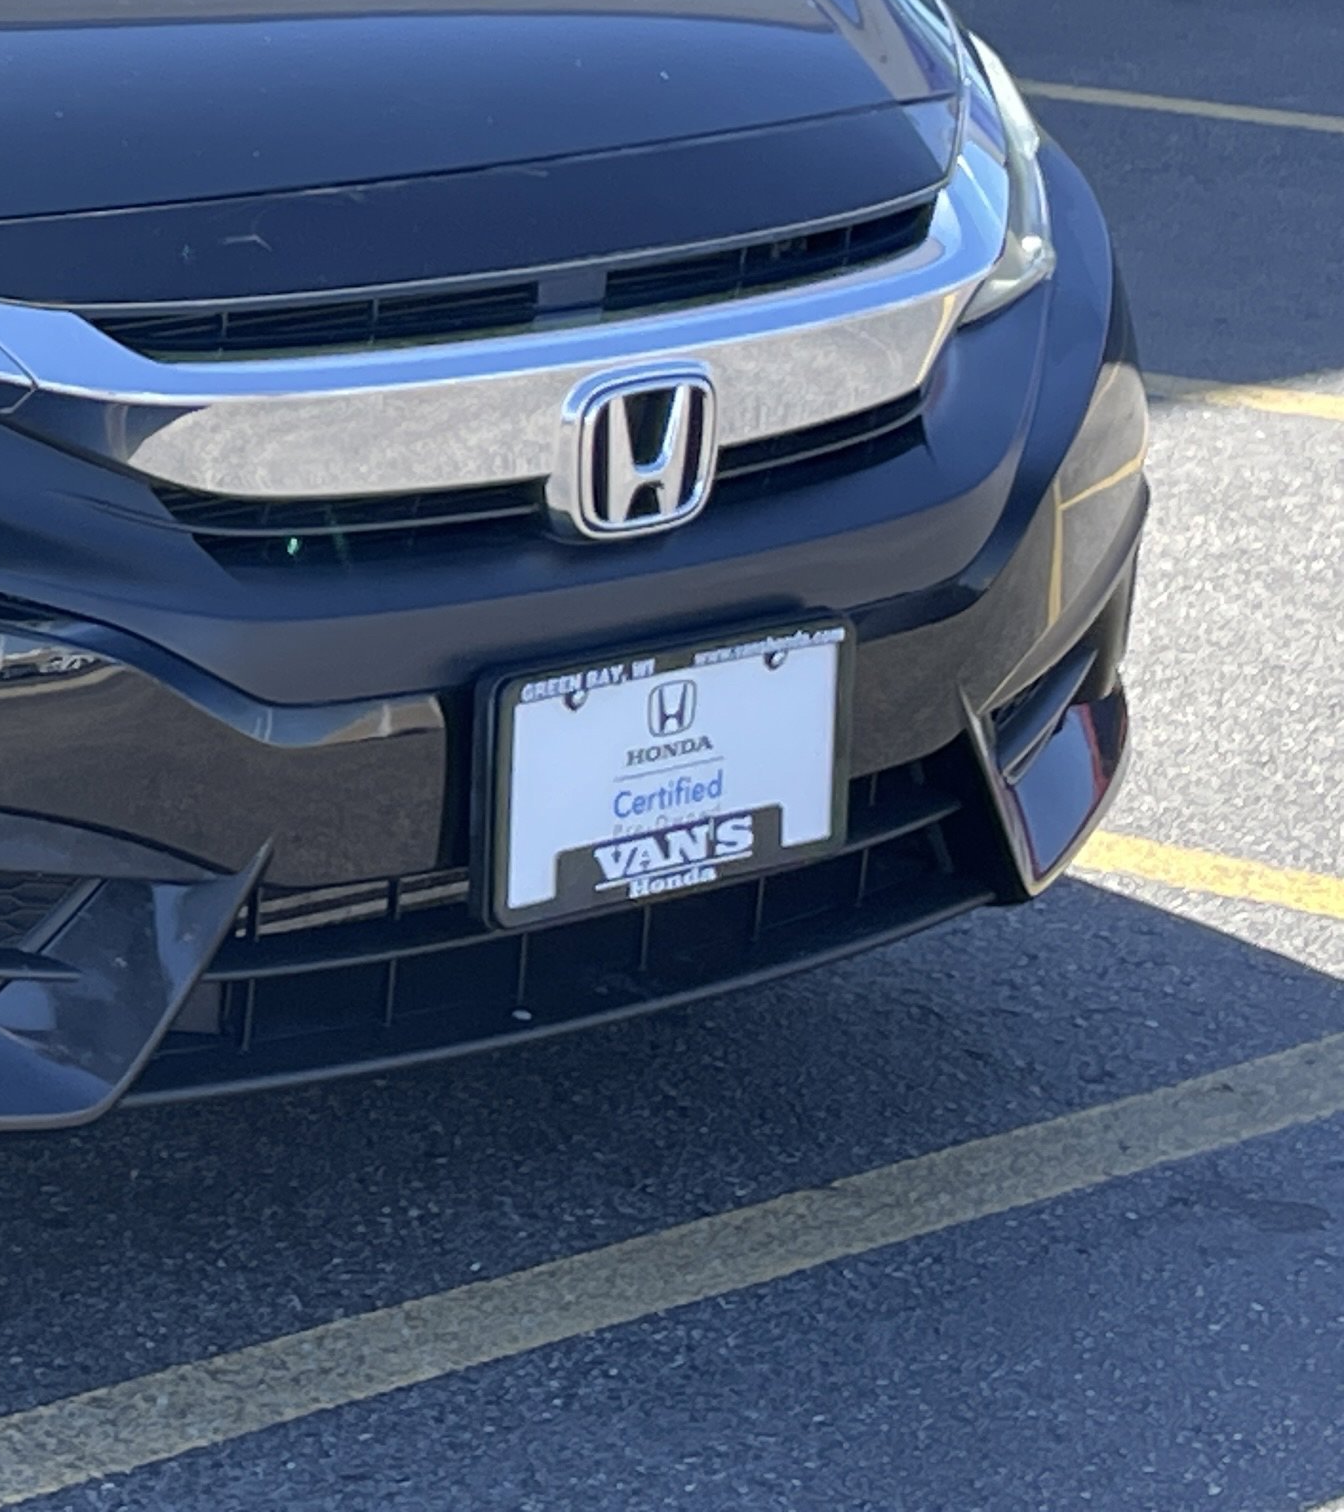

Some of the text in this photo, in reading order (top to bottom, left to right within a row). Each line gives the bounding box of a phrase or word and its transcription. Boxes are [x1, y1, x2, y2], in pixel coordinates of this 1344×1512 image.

[625, 735, 714, 767] HONDA
[613, 769, 723, 819] Certified
[628, 866, 718, 899] Honda
